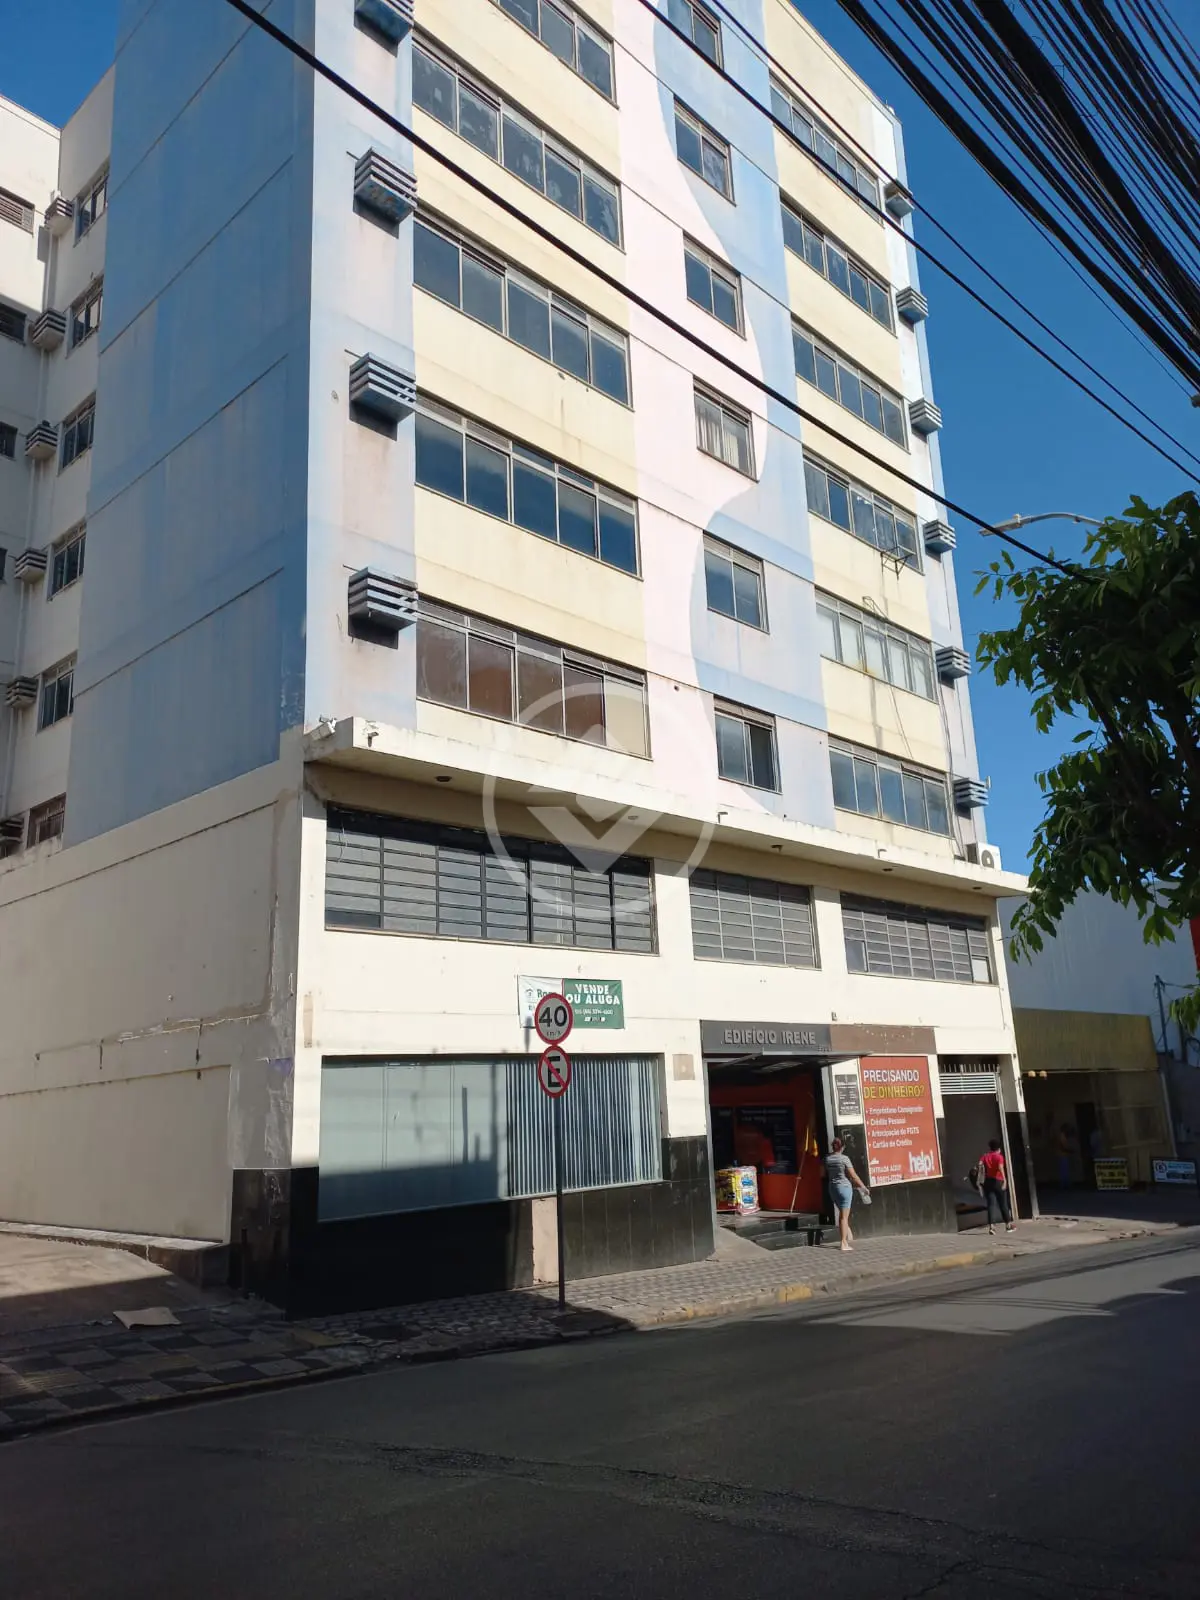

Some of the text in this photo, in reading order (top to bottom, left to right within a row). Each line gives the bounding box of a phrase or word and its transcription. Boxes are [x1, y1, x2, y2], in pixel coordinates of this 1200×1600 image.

[575, 983, 609, 995] VENDE
[566, 993, 581, 1004] OU
[585, 995, 620, 1005] ALUGA
[539, 1005, 567, 1027] 40
[724, 1026, 816, 1046] EDIFÍCIO IRENE
[863, 1070, 919, 1082] PRECISANDO
[864, 1085, 925, 1099] DE DINHEIRO?
[906, 1126, 920, 1135] FGTS
[909, 1150, 935, 1176] help!
